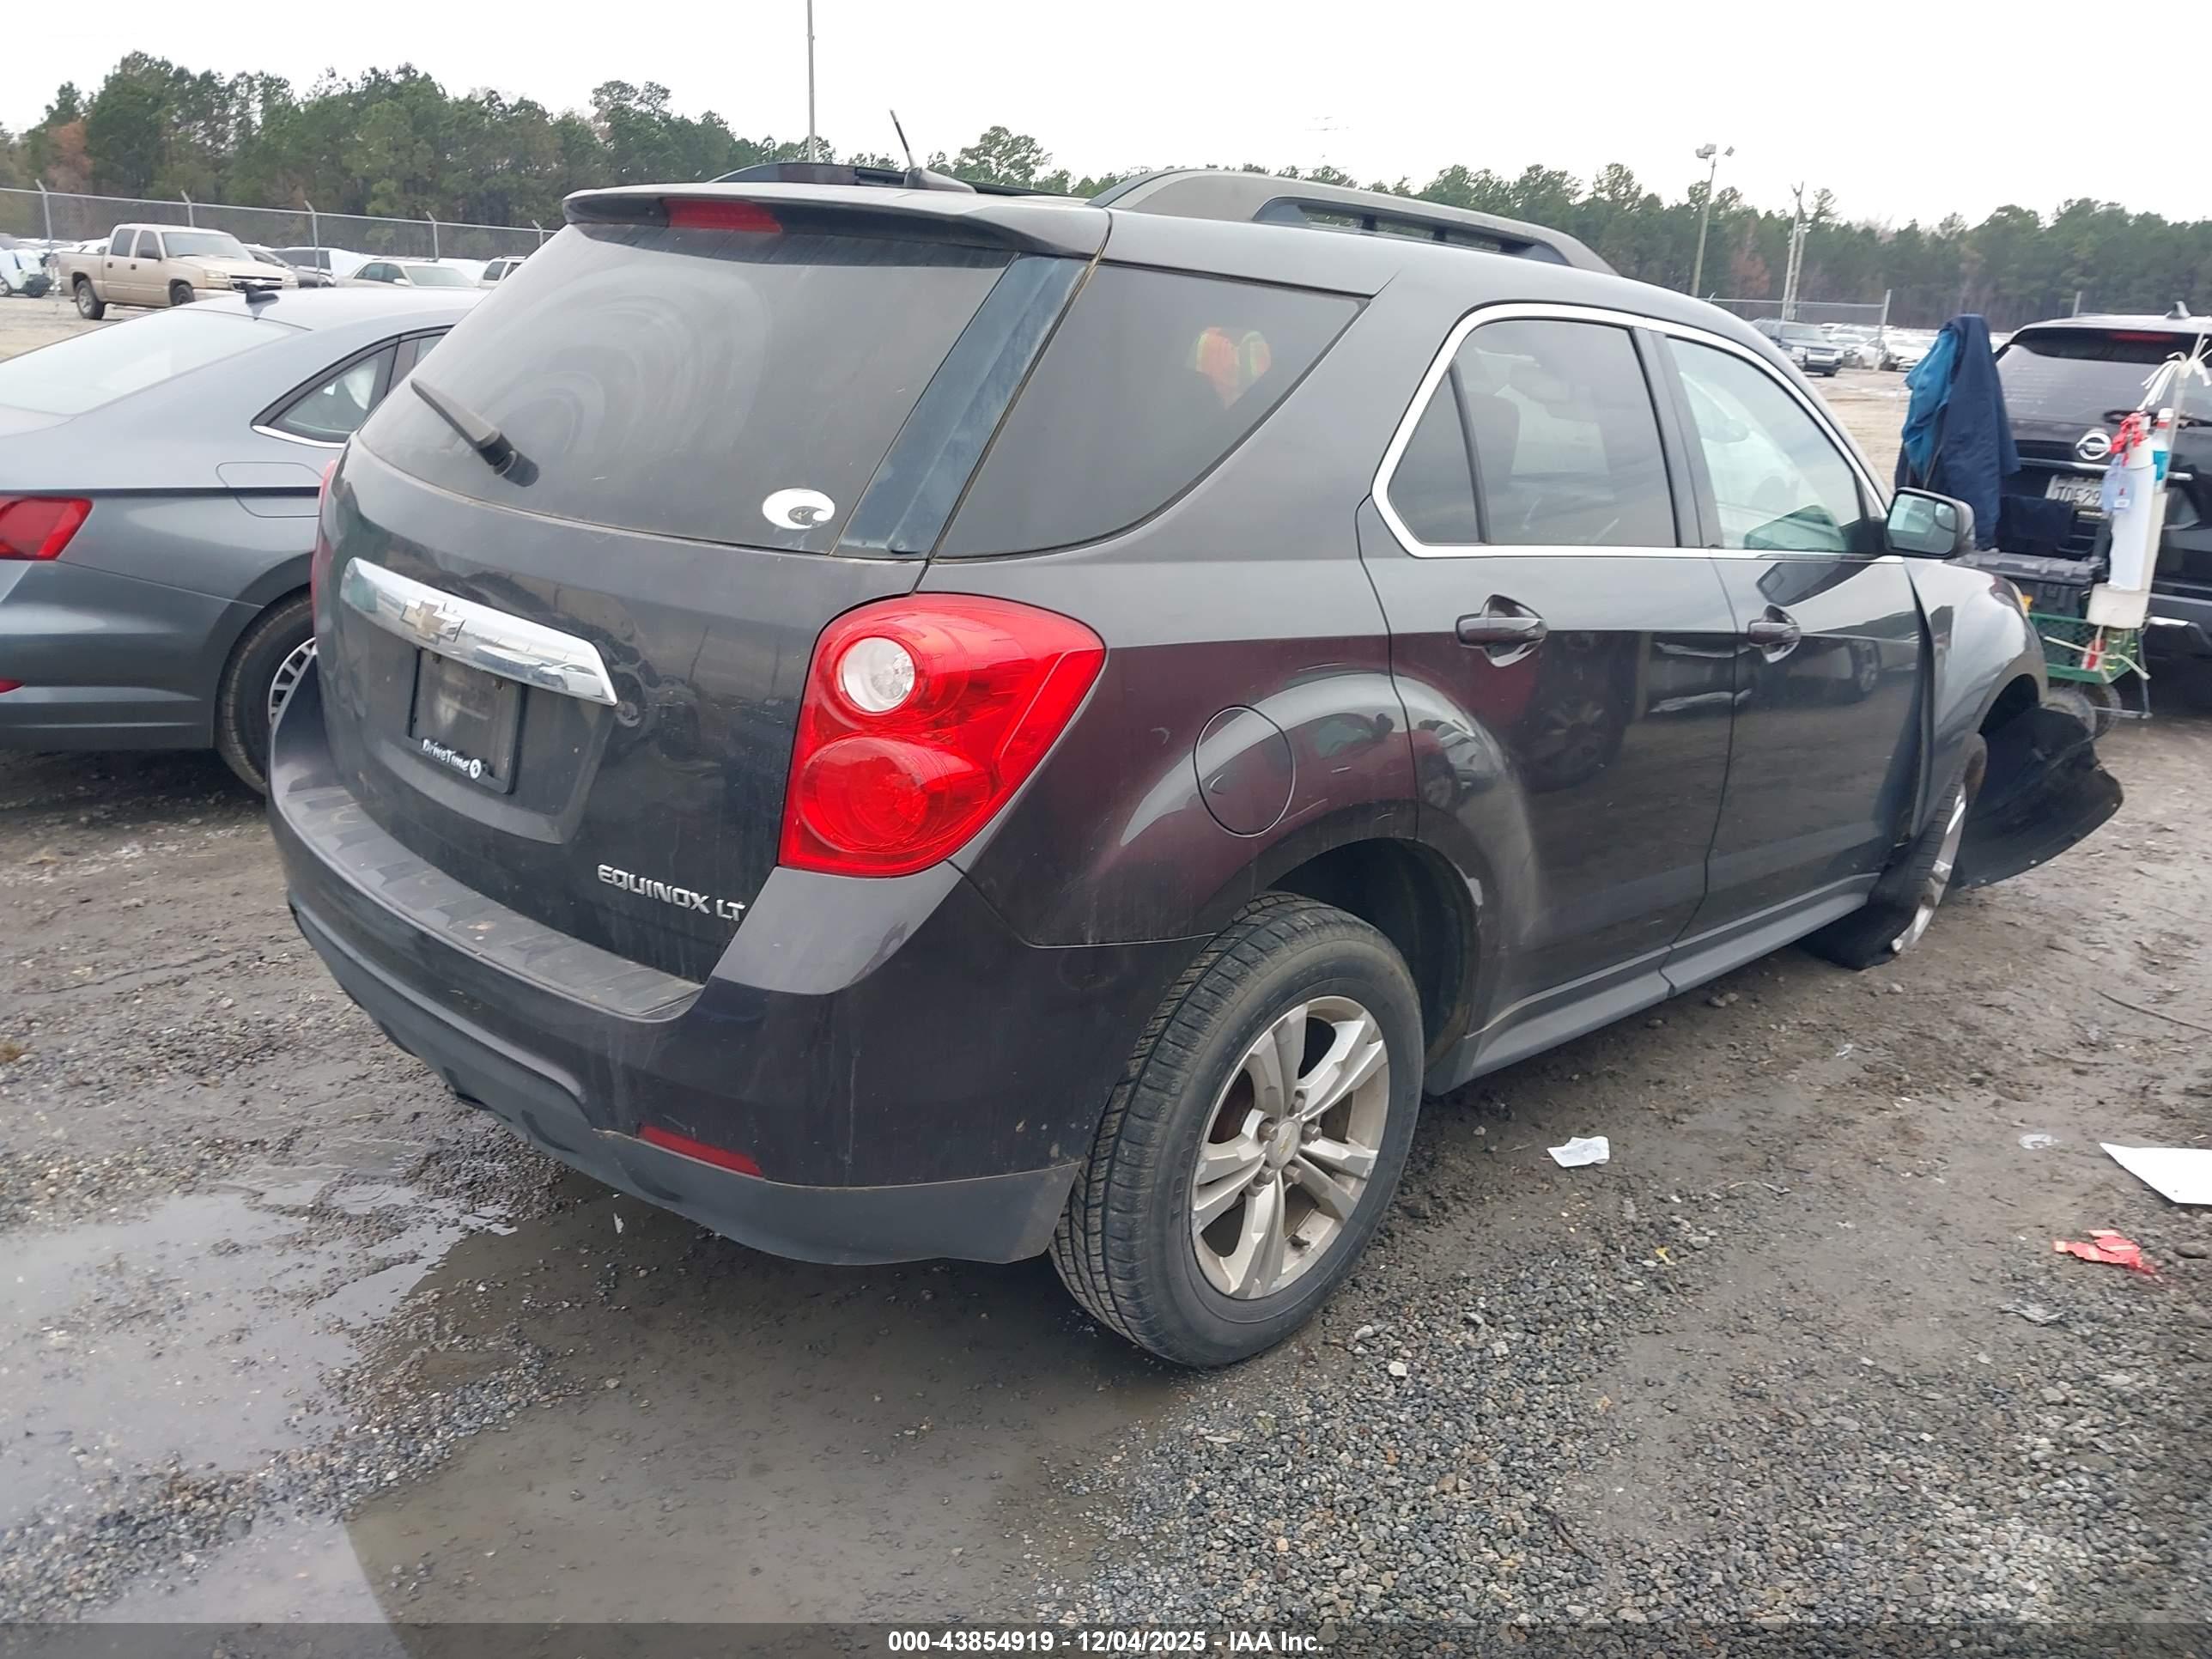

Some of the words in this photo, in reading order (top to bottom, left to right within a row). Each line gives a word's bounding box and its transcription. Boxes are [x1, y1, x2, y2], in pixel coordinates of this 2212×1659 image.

[422, 738, 471, 771] DriveTime
[597, 864, 711, 915] EQUINOX
[715, 899, 746, 921] LT
